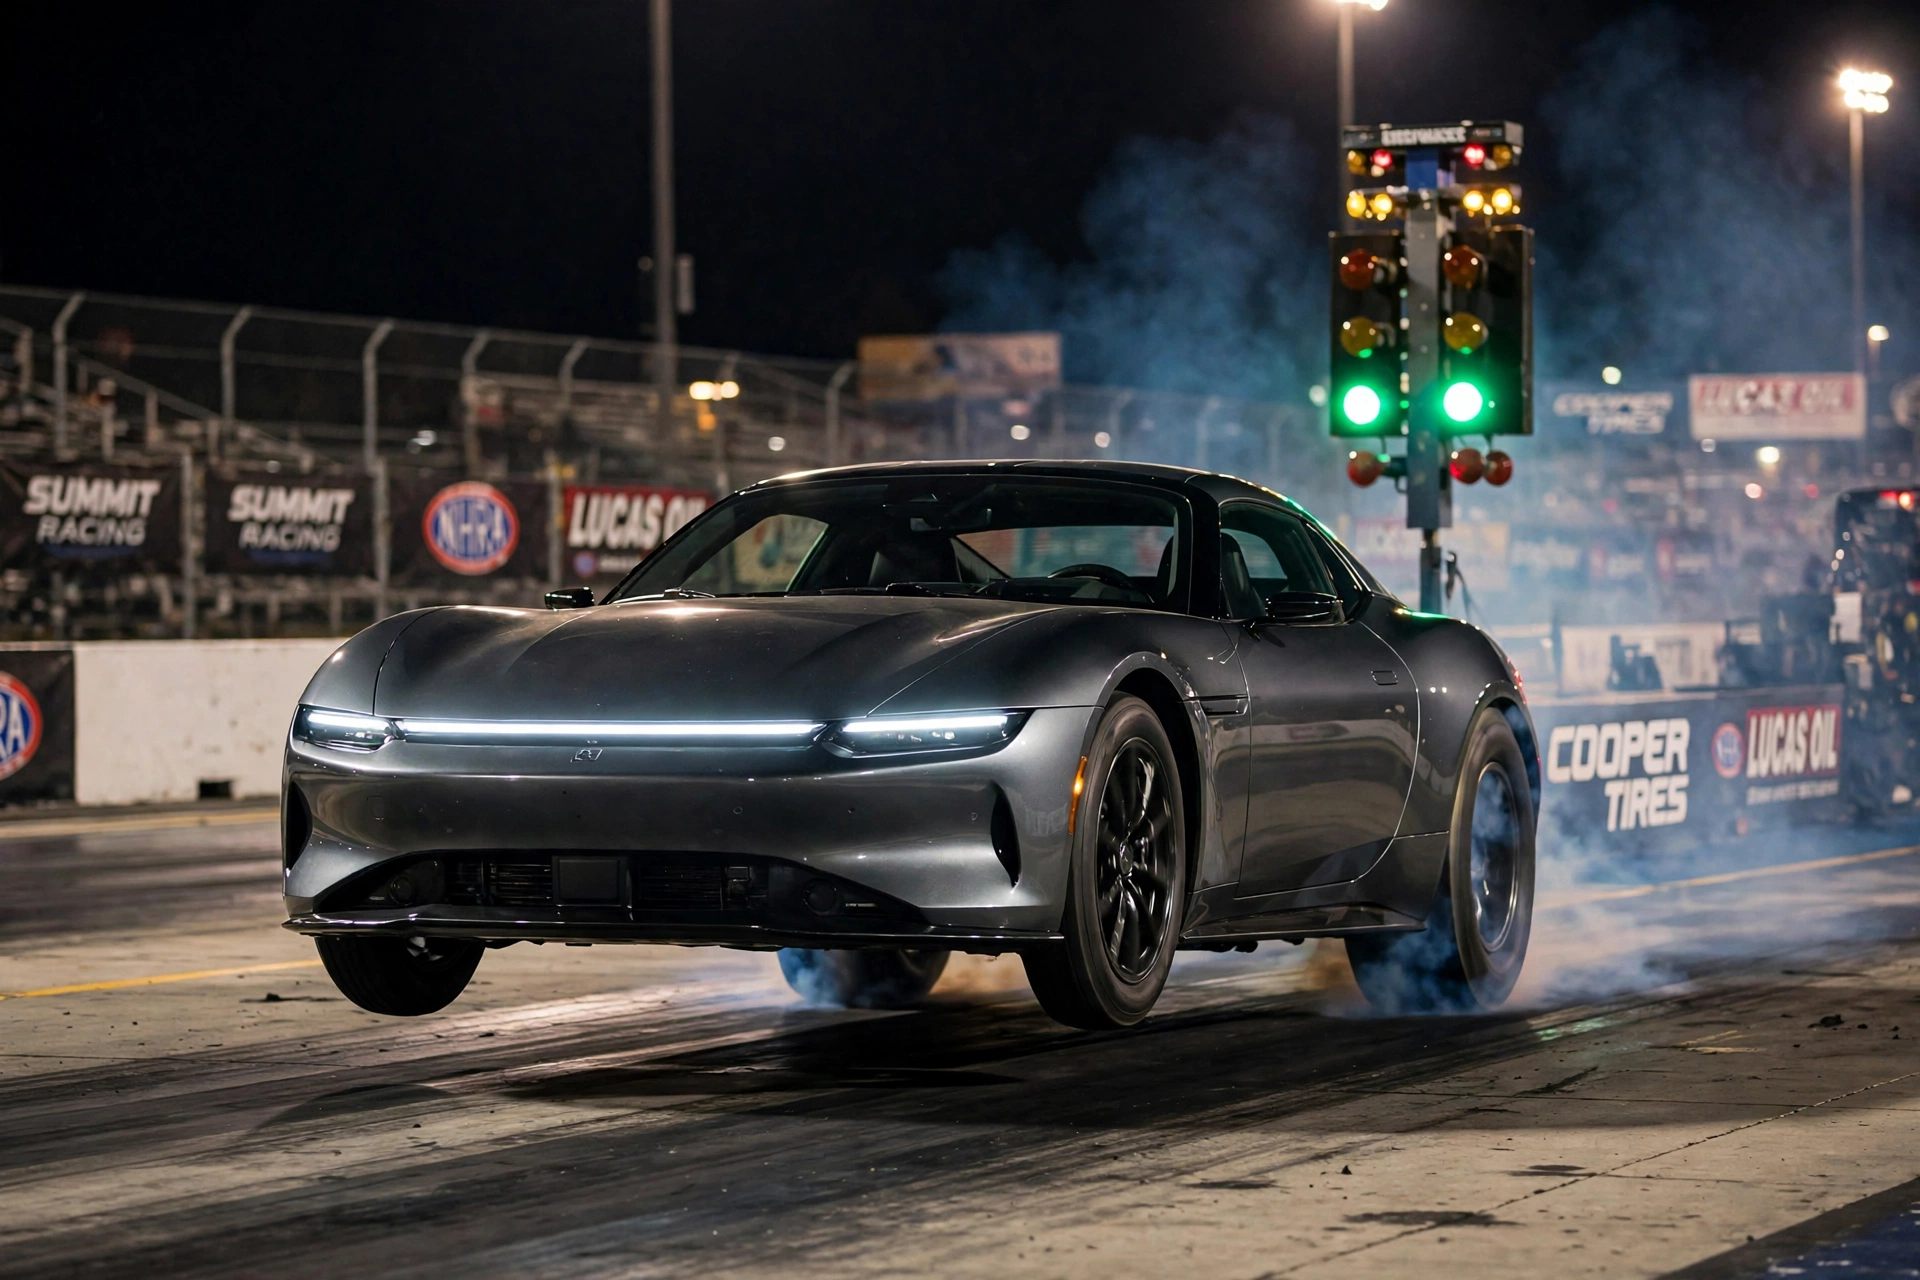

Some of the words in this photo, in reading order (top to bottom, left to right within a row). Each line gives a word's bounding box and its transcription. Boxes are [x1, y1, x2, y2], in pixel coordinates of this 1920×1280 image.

[25, 476, 160, 515] SUMMIT
[228, 485, 354, 523] SUMMIT
[567, 492, 664, 549] LUCAS
[36, 515, 147, 546] RACING
[238, 522, 342, 552] RACING
[437, 499, 507, 556] NHRA
[1547, 718, 1690, 783] COOPER
[1746, 712, 1808, 778] LUCAS
[1809, 708, 1837, 772] OIL
[1604, 774, 1690, 832] TIRES
